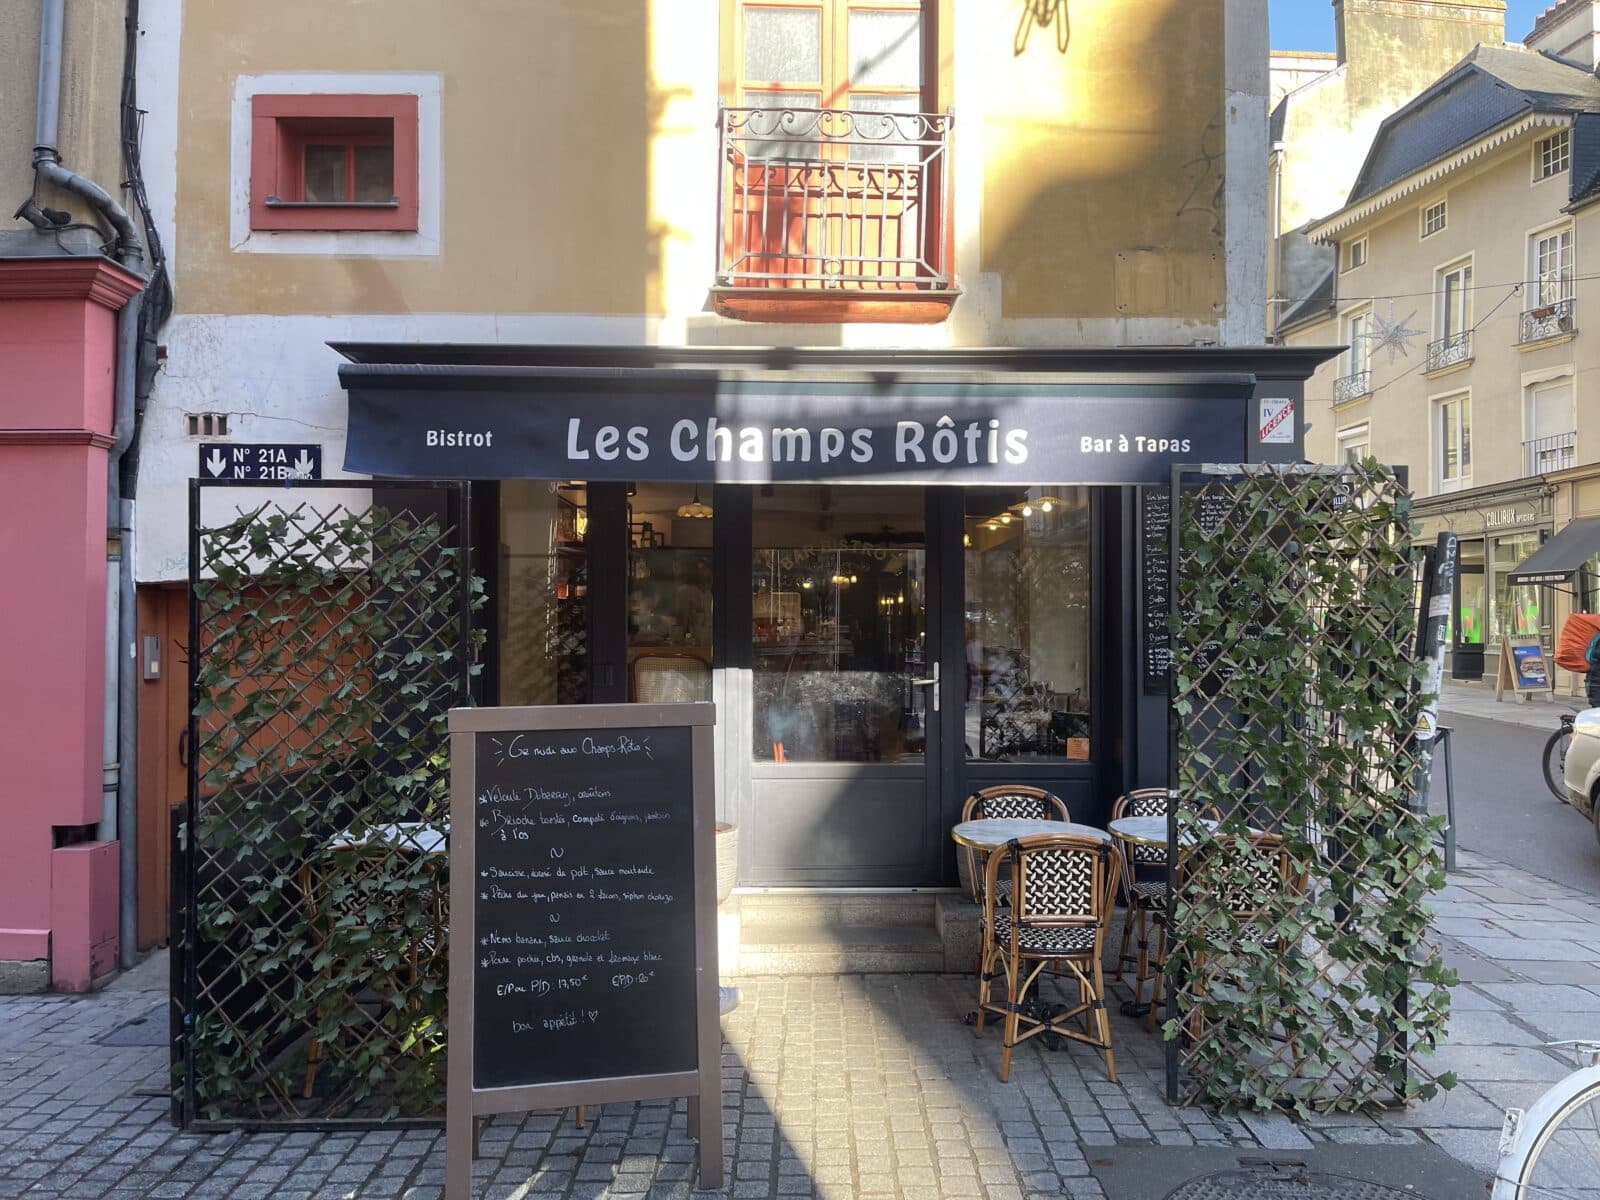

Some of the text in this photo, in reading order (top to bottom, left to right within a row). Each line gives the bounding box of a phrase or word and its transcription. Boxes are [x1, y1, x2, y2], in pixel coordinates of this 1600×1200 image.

[1261, 405, 1295, 439] LICENCE
[426, 430, 493, 447] Bistrot
[567, 415, 1029, 464] Les Champs Rôtis
[1080, 434, 1191, 453] Bar à Tapas
[233, 448, 288, 463] N° 21A
[234, 466, 251, 479] N°
[508, 734, 529, 758] Ce
[534, 745, 556, 756] midi
[560, 747, 578, 755] aux
[501, 827, 529, 841] à l'os
[556, 866, 567, 877] de
[516, 890, 528, 899] du
[588, 888, 595, 900] 2
[512, 1020, 534, 1033] bon
